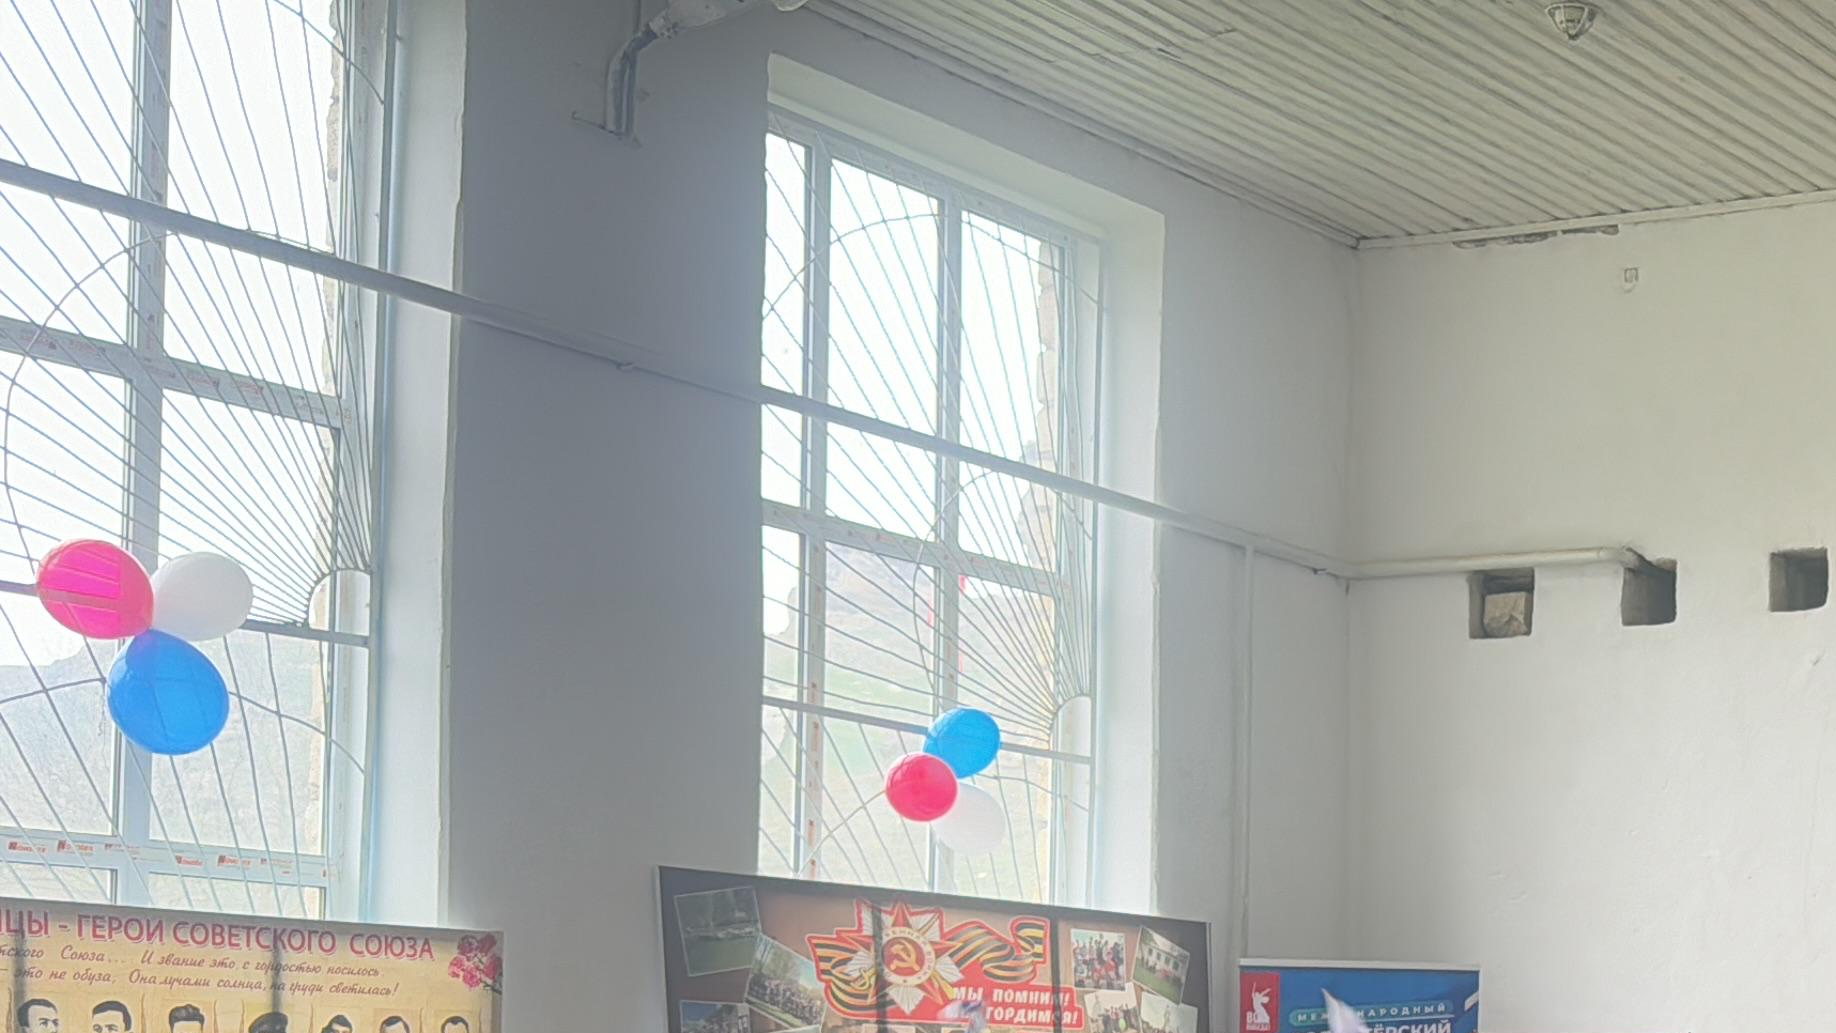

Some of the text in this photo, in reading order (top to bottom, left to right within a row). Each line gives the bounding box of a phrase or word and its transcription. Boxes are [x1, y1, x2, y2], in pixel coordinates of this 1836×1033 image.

[0, 908, 49, 939] ЦЫ
[77, 914, 164, 944] ГЕРОИ
[172, 920, 336, 953] СОВЕТСКОГО
[350, 932, 434, 959] СОЮЗА
[157, 952, 205, 968] звание
[49, 969, 68, 981] не
[953, 986, 984, 1001] МЫ
